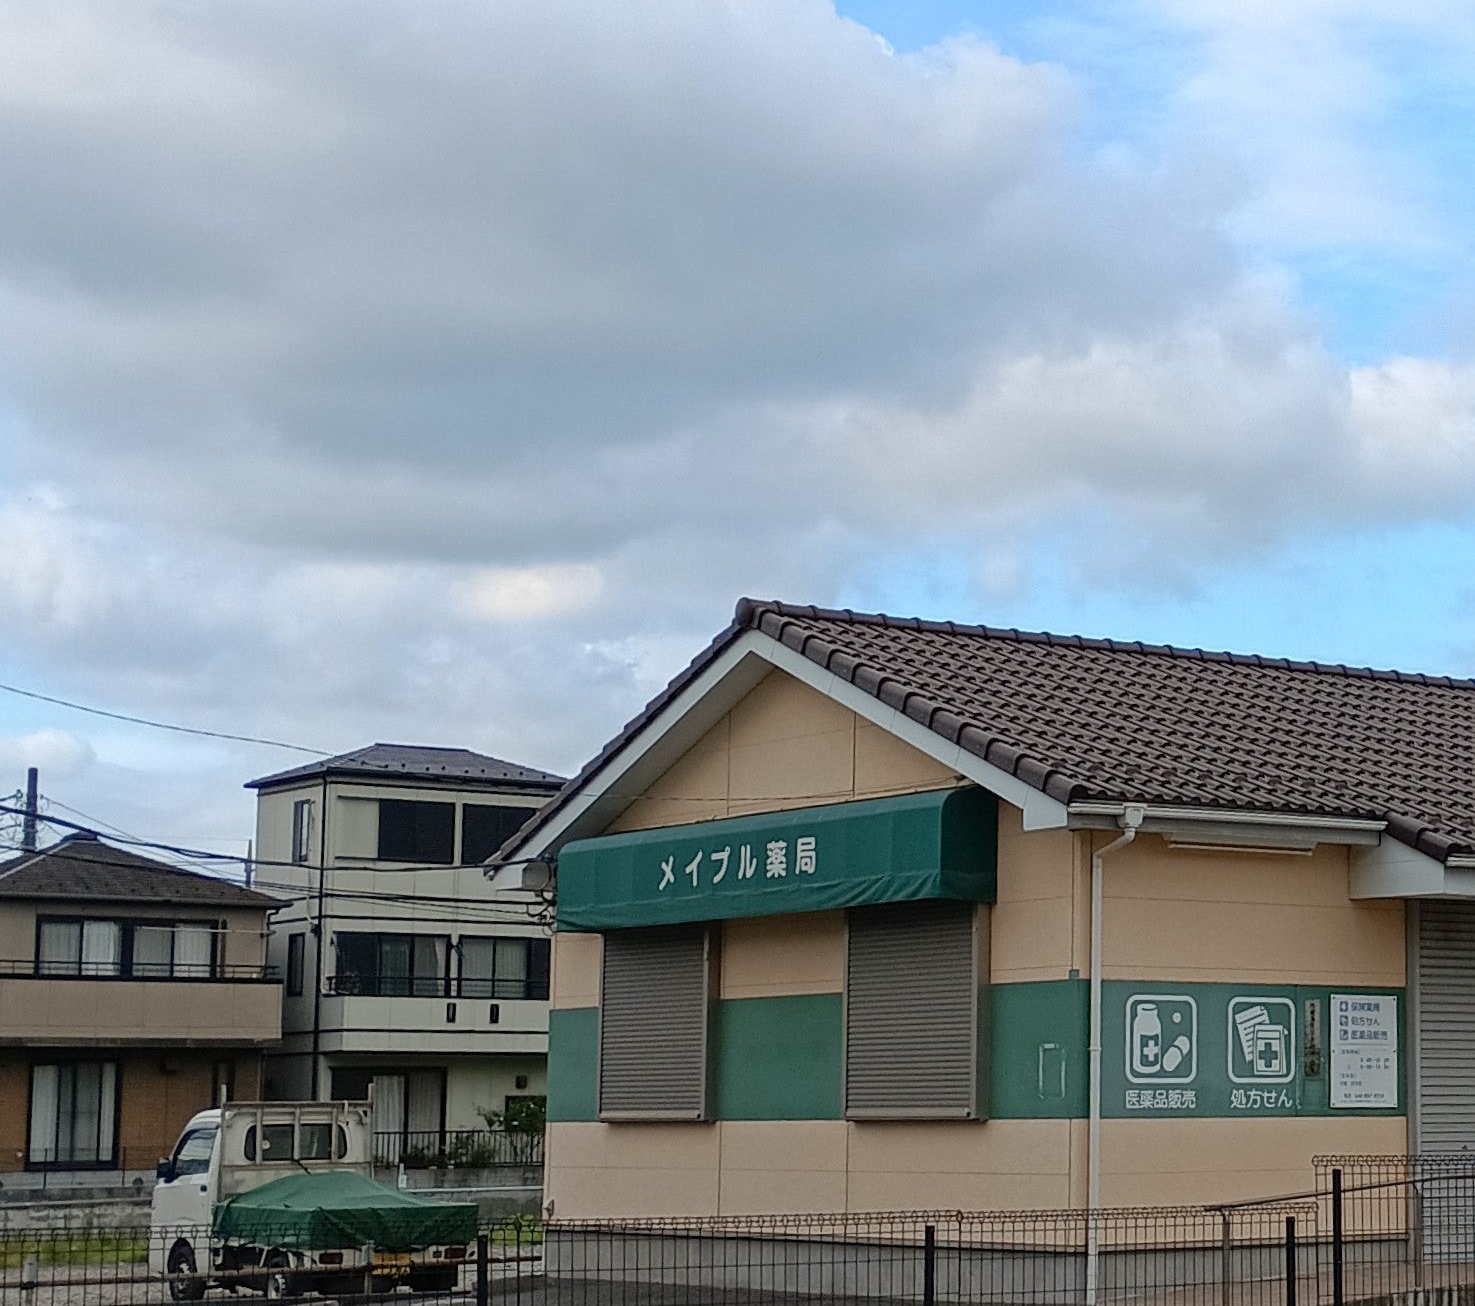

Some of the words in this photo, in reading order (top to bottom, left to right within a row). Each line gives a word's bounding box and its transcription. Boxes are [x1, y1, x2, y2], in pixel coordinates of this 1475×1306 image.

[659, 837, 816, 891] メイプル薬局
[1125, 1089, 1196, 1109] 医薬品販売
[1230, 1089, 1293, 1109] 処方せん
